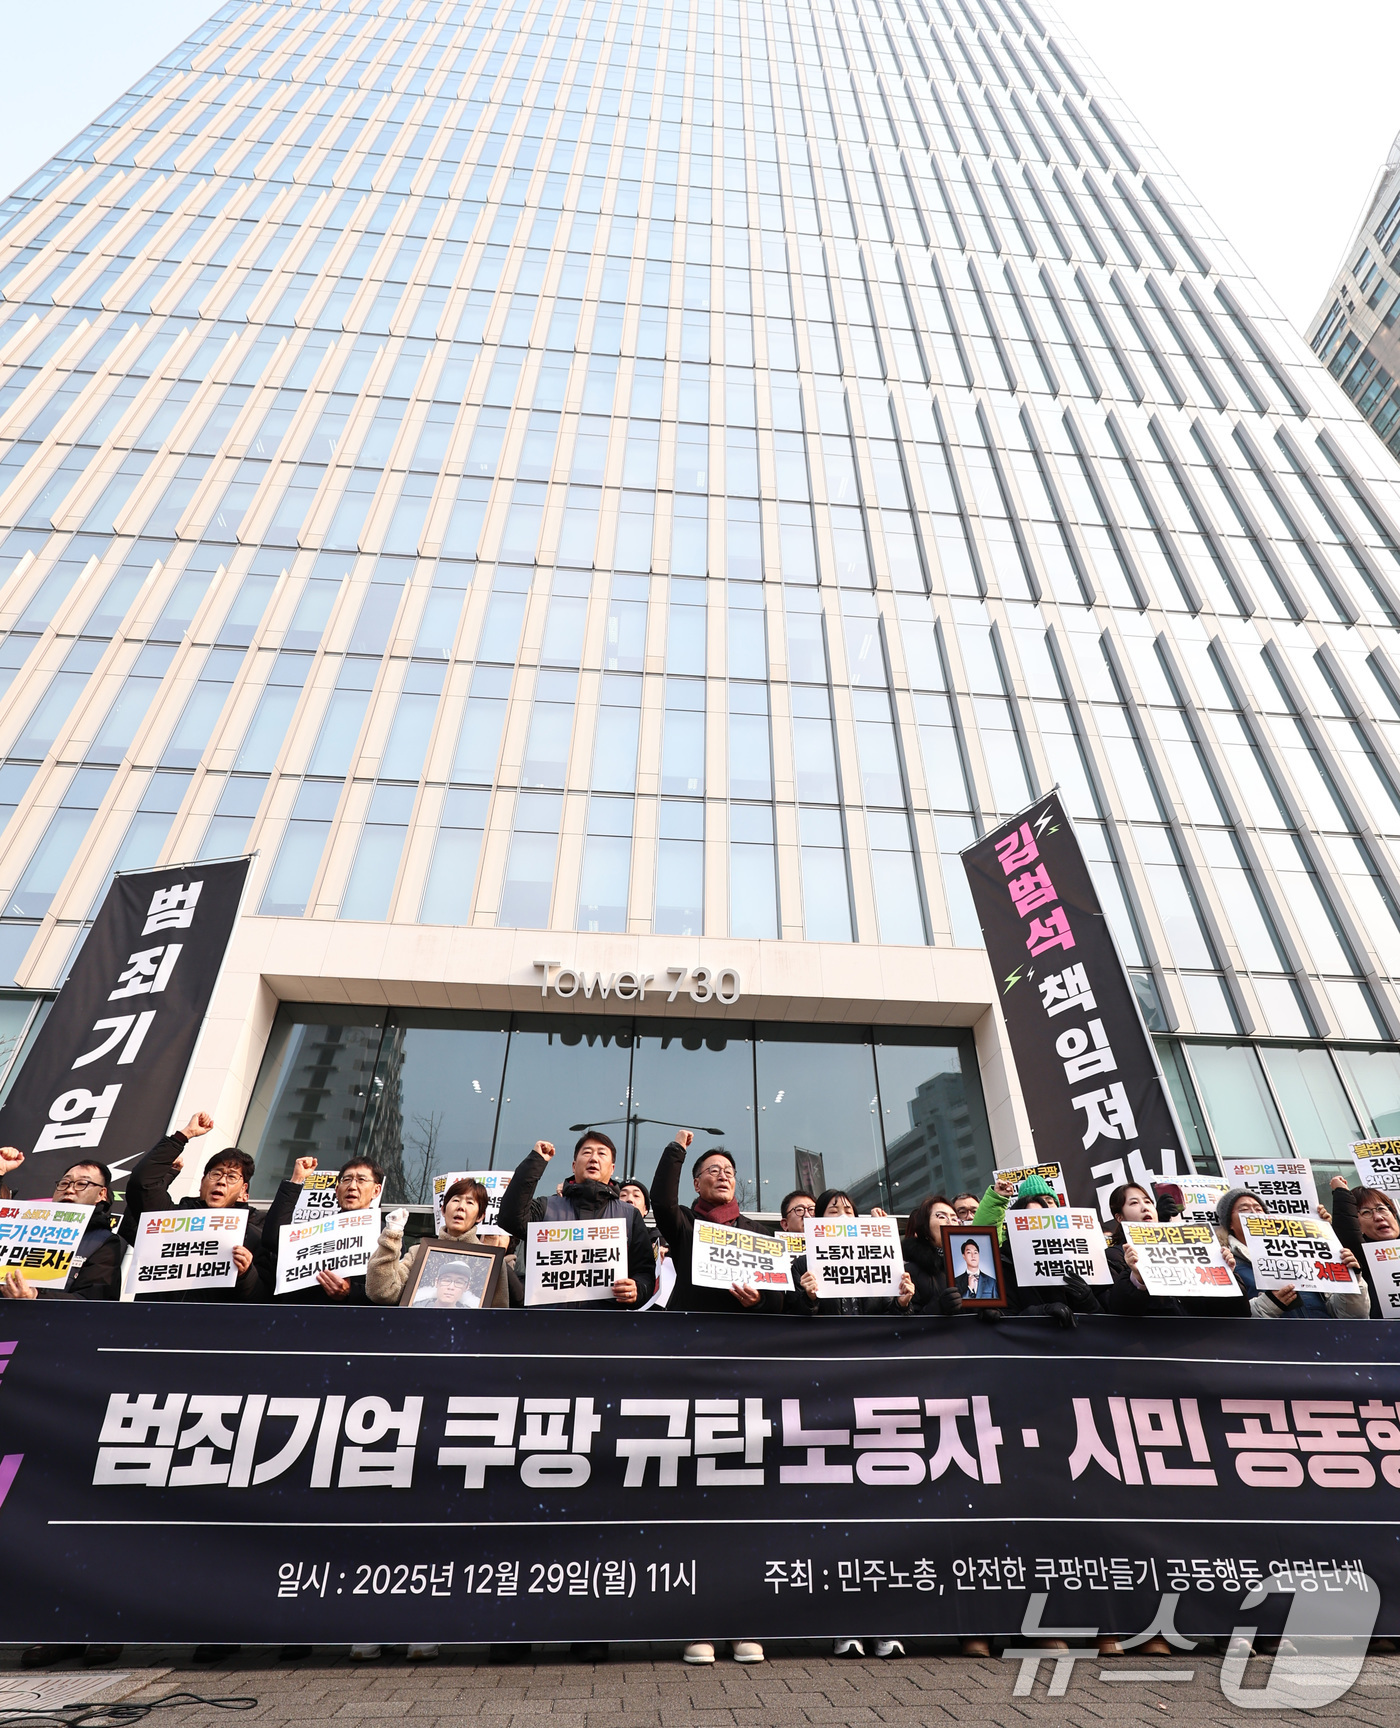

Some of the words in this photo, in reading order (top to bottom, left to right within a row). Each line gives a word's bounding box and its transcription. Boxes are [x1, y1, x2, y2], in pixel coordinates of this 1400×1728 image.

[994, 822, 1076, 957] 김범석
[533, 961, 654, 1000] Tower
[666, 967, 740, 1004] 730
[32, 880, 204, 1153] 범죄기업
[1037, 1165, 1059, 1179] 쿠팡
[1233, 1164, 1275, 1175] 살인기업
[1277, 1164, 1307, 1175] 쿠팡은
[1244, 1181, 1302, 1195] 노동환경
[1366, 1174, 1400, 1191] 책임
[307, 1192, 340, 1209] 진상
[1266, 1200, 1310, 1214] 선하라!
[146, 1216, 206, 1234] 살인기업
[209, 1215, 241, 1231] 쿠팡
[289, 1220, 335, 1242] 살인기업
[337, 1215, 373, 1228] 쿠팡은
[813, 1224, 858, 1237] 살인기업
[860, 1224, 892, 1237] 쿠팡은
[1014, 1214, 1069, 1231] 범죄기업
[1071, 1214, 1094, 1230] 쿠팡
[1246, 1217, 1306, 1238] 불법기업
[27, 1225, 79, 1246] 안전한
[536, 1228, 584, 1242] 살인기업
[587, 1225, 620, 1240] 쿠팡은
[698, 1225, 754, 1251] 불법기업
[754, 1237, 783, 1257] 쿠팡
[1128, 1226, 1184, 1244] 불법기업
[1182, 1226, 1213, 1244] 쿠팡
[161, 1240, 219, 1258] 김범석은
[295, 1236, 363, 1261] 유족들에게
[535, 1249, 578, 1266] 노동자
[580, 1247, 621, 1263] 과로사
[815, 1245, 854, 1260] 노동자
[857, 1245, 895, 1260] 과로사
[1032, 1238, 1089, 1255] 김범석을
[1145, 1246, 1211, 1264] 진상규명
[1263, 1239, 1333, 1260] 진상규명
[1374, 1246, 1400, 1262] 살인
[6, 1246, 75, 1270] 만들자!
[709, 1246, 774, 1271] 진상규명
[138, 1263, 183, 1281] 청문회
[186, 1260, 231, 1278] 나와라
[698, 1261, 751, 1284] 책임자
[753, 1271, 788, 1284] 처벌
[822, 1265, 892, 1285] 책임져라!
[1033, 1260, 1095, 1277] 처벌하라!
[1143, 1266, 1198, 1286] 책임자
[1195, 1266, 1233, 1286] 처벌
[1257, 1259, 1314, 1281] 책임자
[1314, 1261, 1353, 1282] 처벌
[541, 1268, 615, 1290] 책임져라!
[92, 1393, 424, 1488] 범죄기업
[438, 1396, 601, 1489] 쿠팡
[616, 1397, 772, 1487] 규탄
[779, 1395, 1004, 1486] 노동자
[1068, 1396, 1219, 1486] 시민
[277, 1561, 330, 1598] 일시
[353, 1561, 454, 1597] 2025년
[463, 1560, 520, 1597] 12월
[528, 1559, 637, 1598] 29일(월)
[646, 1559, 697, 1595] 11시
[764, 1559, 812, 1594] 주최
[837, 1558, 945, 1597] 민주노총,
[952, 1556, 1026, 1592] 안전한
[1034, 1556, 1160, 1592] 쿠팡만들기
[1166, 1558, 1263, 1593] 공동행동
[1268, 1558, 1369, 1593] 연명단체
